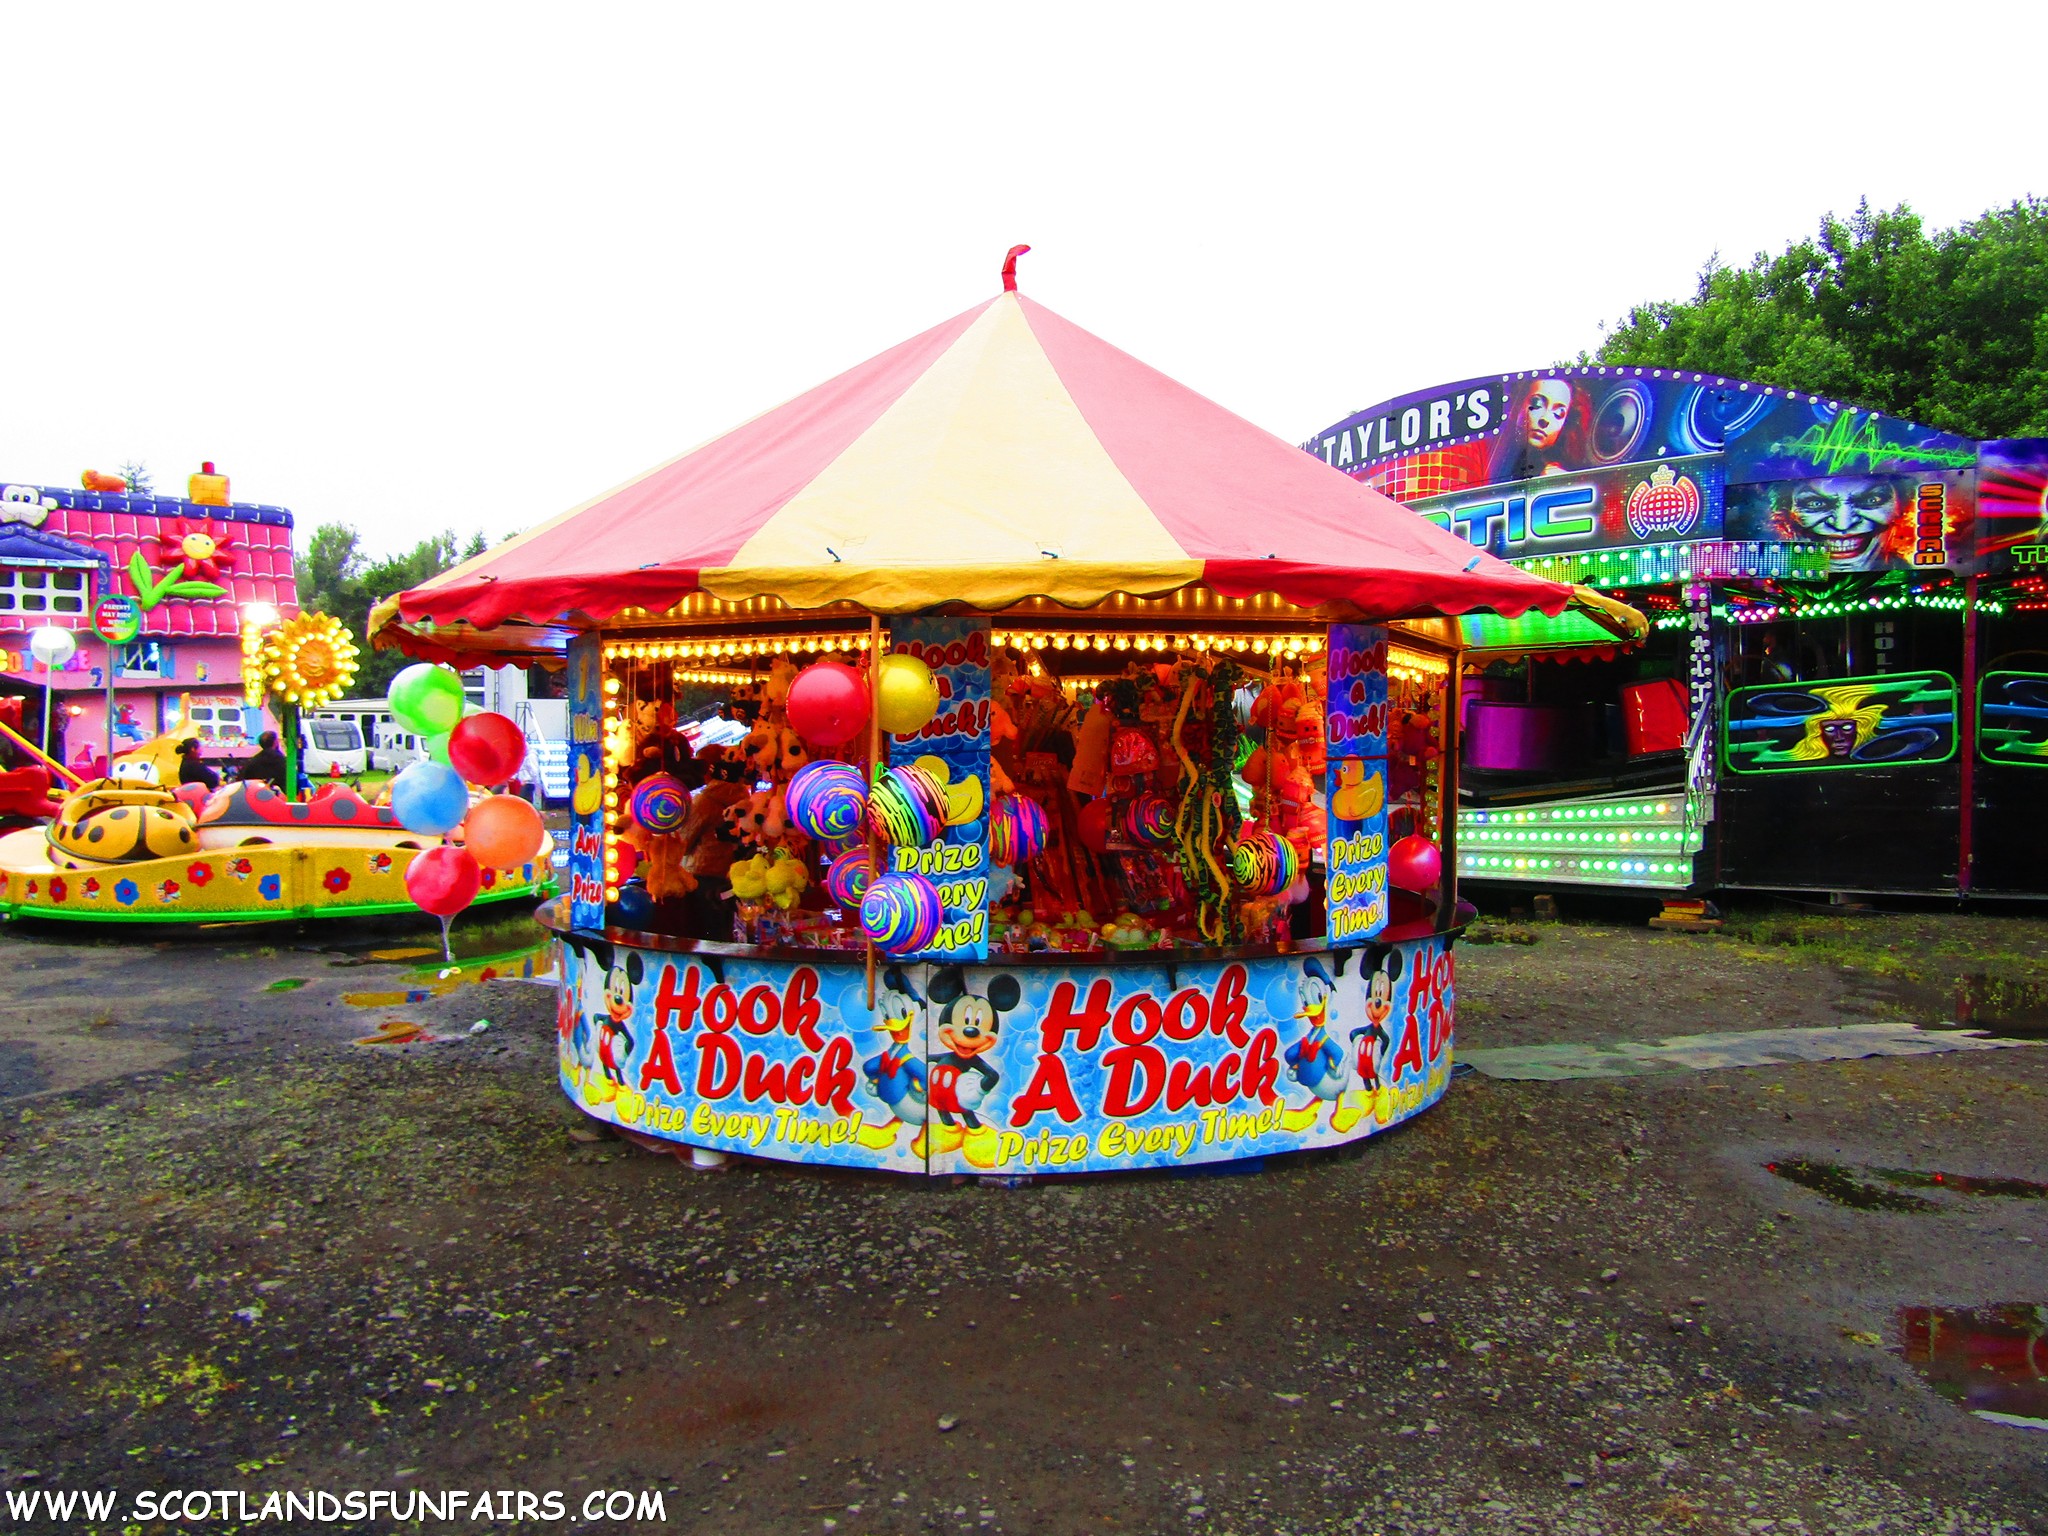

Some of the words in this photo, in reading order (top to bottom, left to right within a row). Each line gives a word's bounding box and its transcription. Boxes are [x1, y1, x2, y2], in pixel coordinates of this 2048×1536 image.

[1323, 389, 1490, 467] TAYLOR'S
[1421, 488, 1592, 546] TIC
[1630, 486, 1646, 535] HOLLAND
[1914, 484, 1945, 565] SCREAM
[1330, 641, 1387, 681] Hook
[1350, 680, 1366, 705] A
[895, 699, 990, 743] uck!
[1328, 703, 1387, 744] Duck!
[575, 824, 600, 861] Any
[896, 840, 981, 875] Prize
[1331, 831, 1383, 869] Prize
[572, 872, 602, 904] Prize
[936, 879, 986, 912] ery
[1331, 864, 1386, 903] Every
[1331, 893, 1385, 938] Time!
[655, 965, 824, 1052] Hook
[1041, 964, 1251, 1054] Hook
[1392, 1015, 1422, 1083] A
[639, 1029, 682, 1096] A
[696, 1033, 859, 1117] Duck
[1010, 1052, 1082, 1127] A
[1102, 1028, 1281, 1116] Duck
[632, 1094, 685, 1131] Prize
[692, 1107, 771, 1148] Every
[775, 1108, 863, 1148] Time!
[998, 1128, 1089, 1166] Prize
[1098, 1122, 1197, 1158] Every
[1200, 1099, 1286, 1144] Time!
